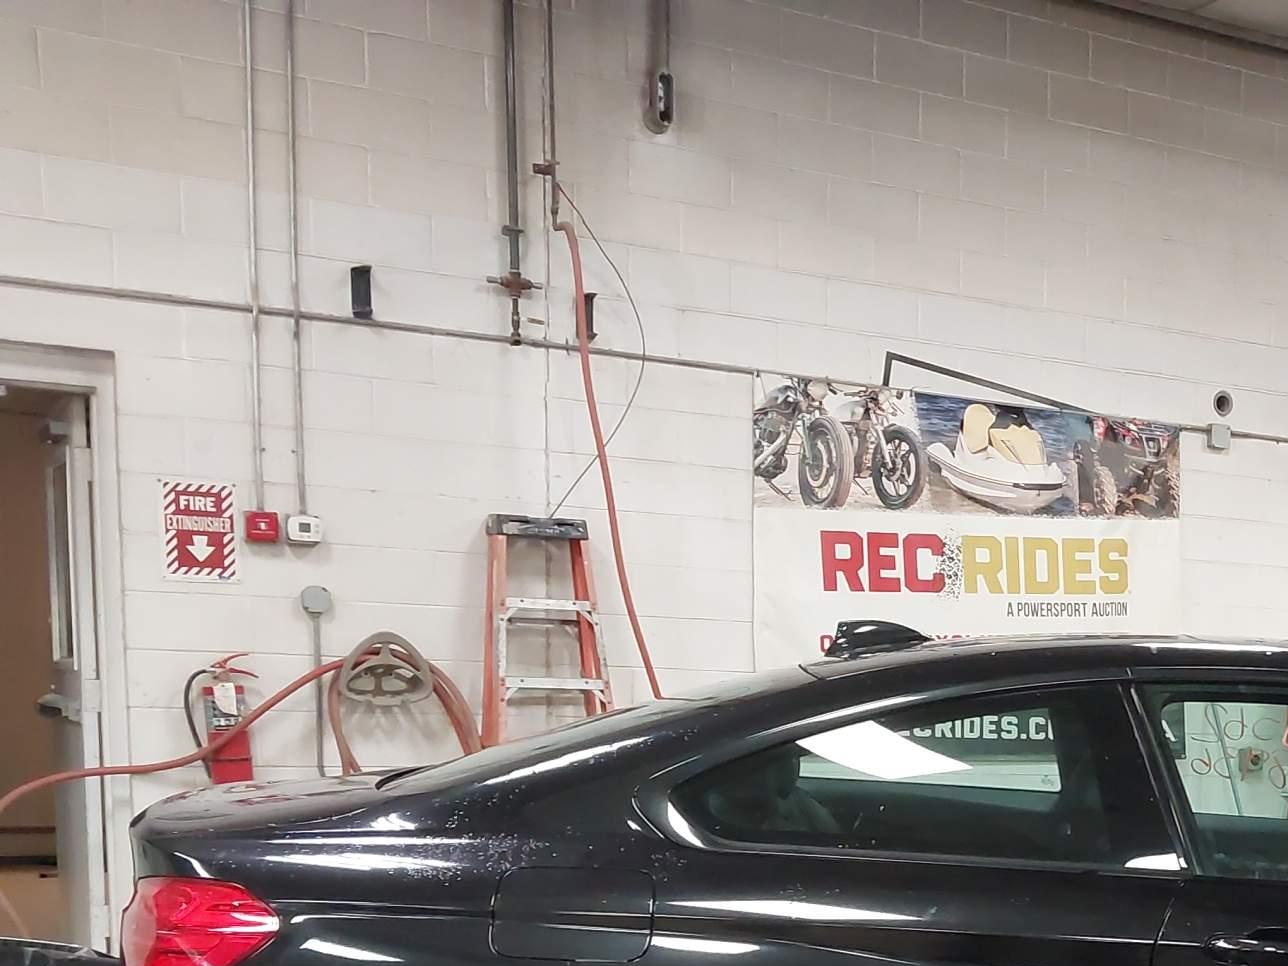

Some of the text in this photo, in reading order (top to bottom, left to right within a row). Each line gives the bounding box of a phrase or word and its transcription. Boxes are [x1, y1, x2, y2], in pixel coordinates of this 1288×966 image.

[179, 495, 216, 512] FIRE
[166, 514, 232, 532] EXTINGUISHER
[820, 530, 1129, 595] REC RIDES
[1006, 601, 1128, 617] A POWERSPORT AUCTION
